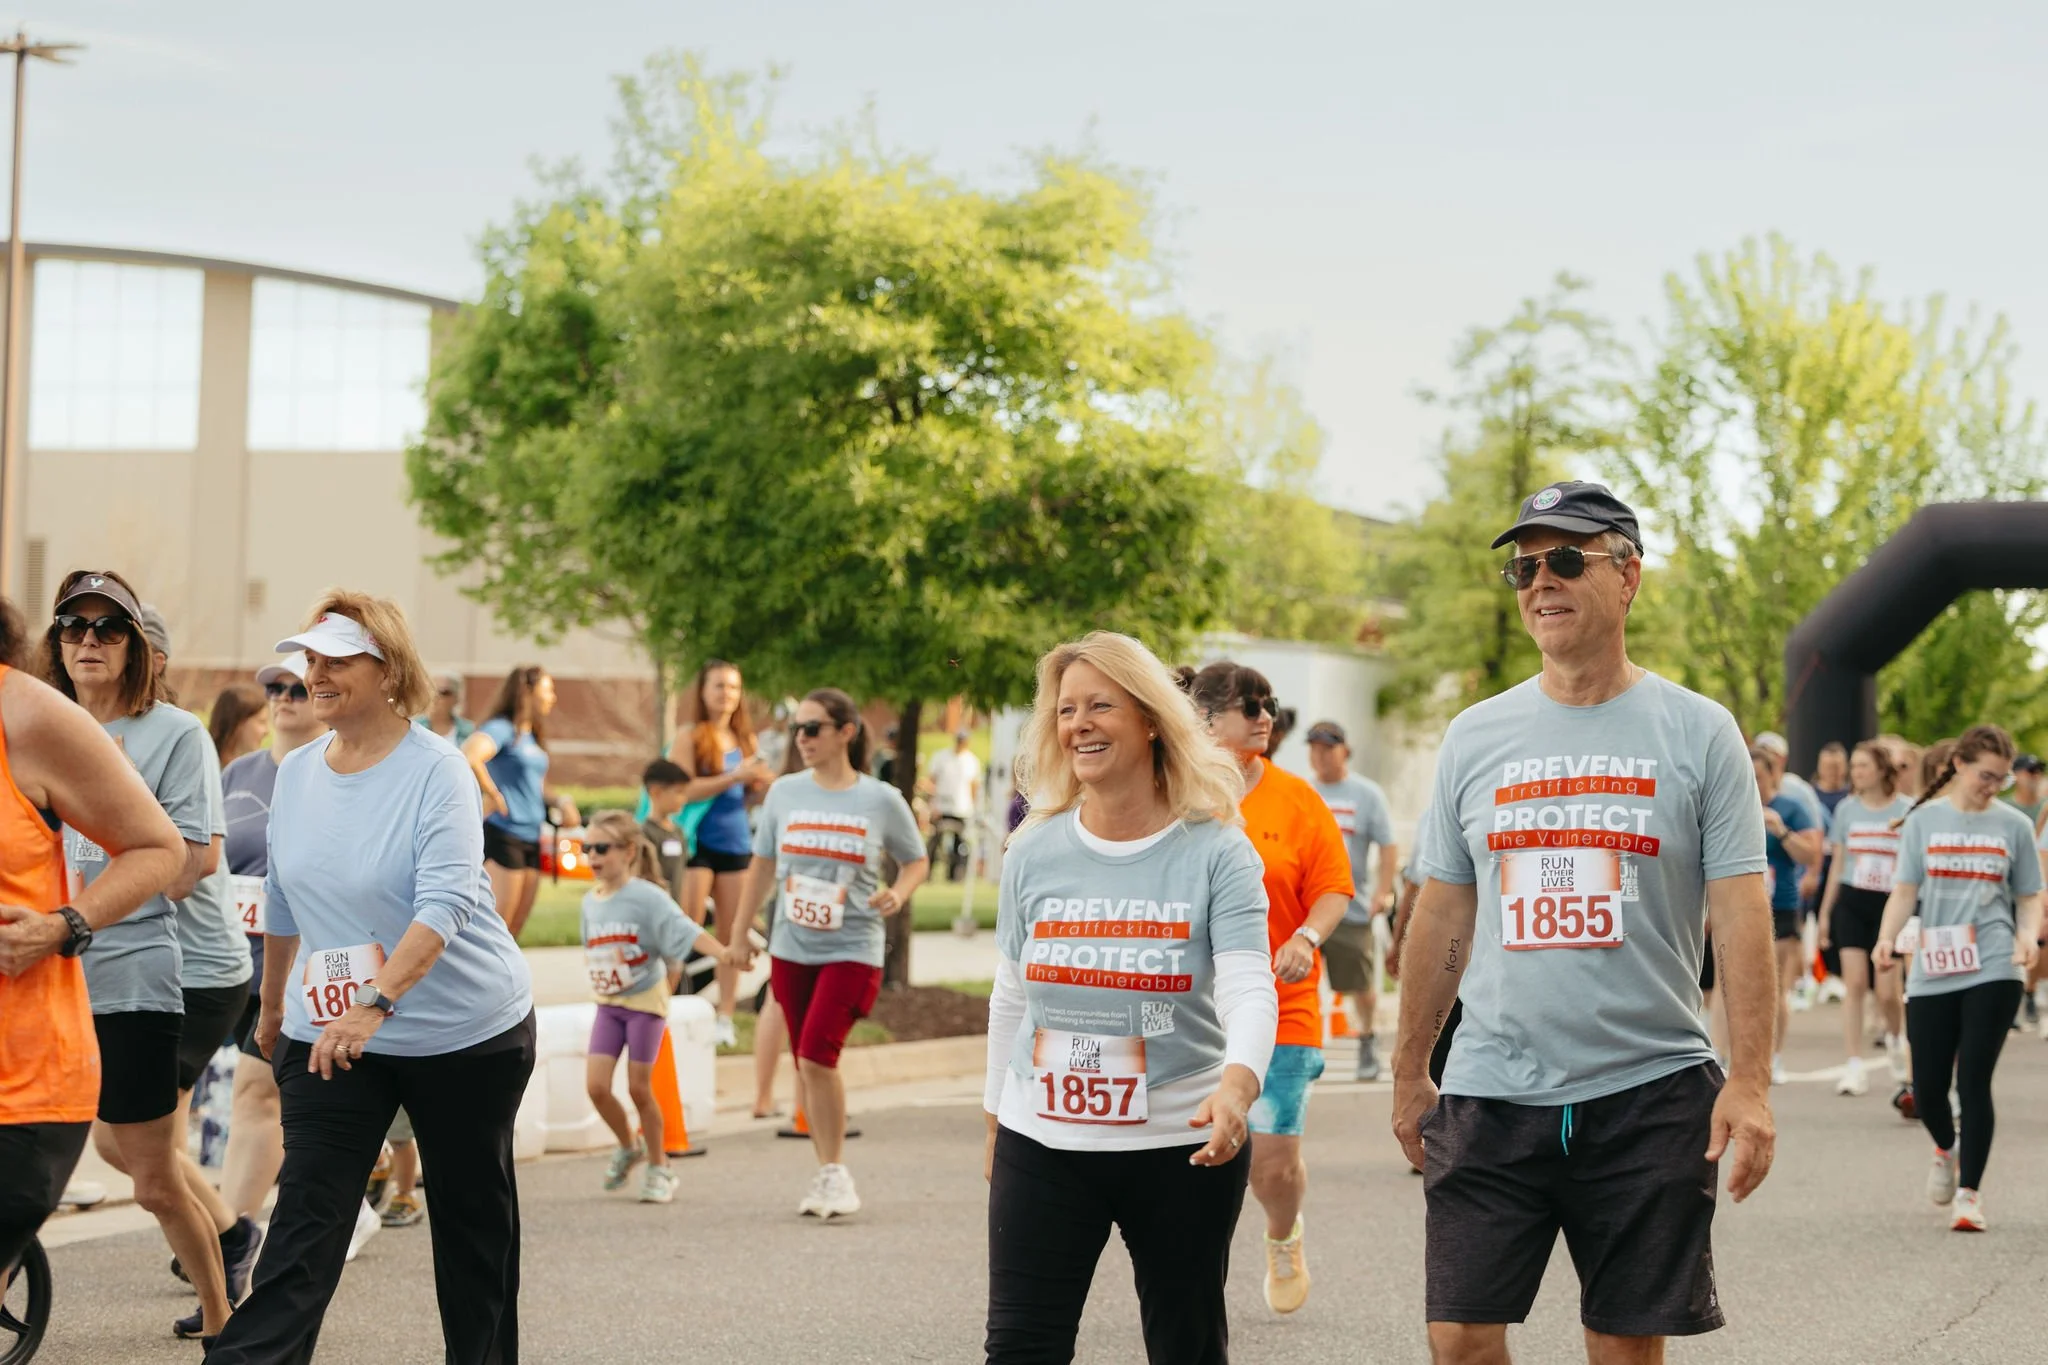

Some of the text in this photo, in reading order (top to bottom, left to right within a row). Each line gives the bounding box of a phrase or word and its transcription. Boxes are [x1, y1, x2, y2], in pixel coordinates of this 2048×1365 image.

[1502, 755, 1658, 788] PREVENT
[1507, 778, 1638, 800] Trafficking
[1494, 804, 1653, 836] PROTECT
[1491, 831, 1653, 853] The Vulnerable
[1541, 856, 1574, 870] RUN
[1550, 869, 1574, 877] THEIR
[1619, 863, 1638, 878] UN
[1541, 877, 1574, 887] LIVES
[793, 898, 831, 926] 553
[1042, 897, 1191, 922] PREVENT
[1508, 895, 1613, 940] 1855
[1047, 922, 1173, 939] Trafficking
[325, 952, 349, 965] RUN
[1032, 942, 1185, 976] PROTECT
[1926, 947, 1974, 970] 1910
[326, 967, 351, 978] LIVES
[1028, 965, 1187, 990] The Vulnerable
[307, 979, 374, 1018] 180
[1141, 1002, 1175, 1017] RUN
[1142, 1018, 1175, 1033] LIVES
[1072, 1038, 1101, 1052] RUN
[1069, 1057, 1101, 1069] LIVES
[1040, 1072, 1138, 1117] 1857
